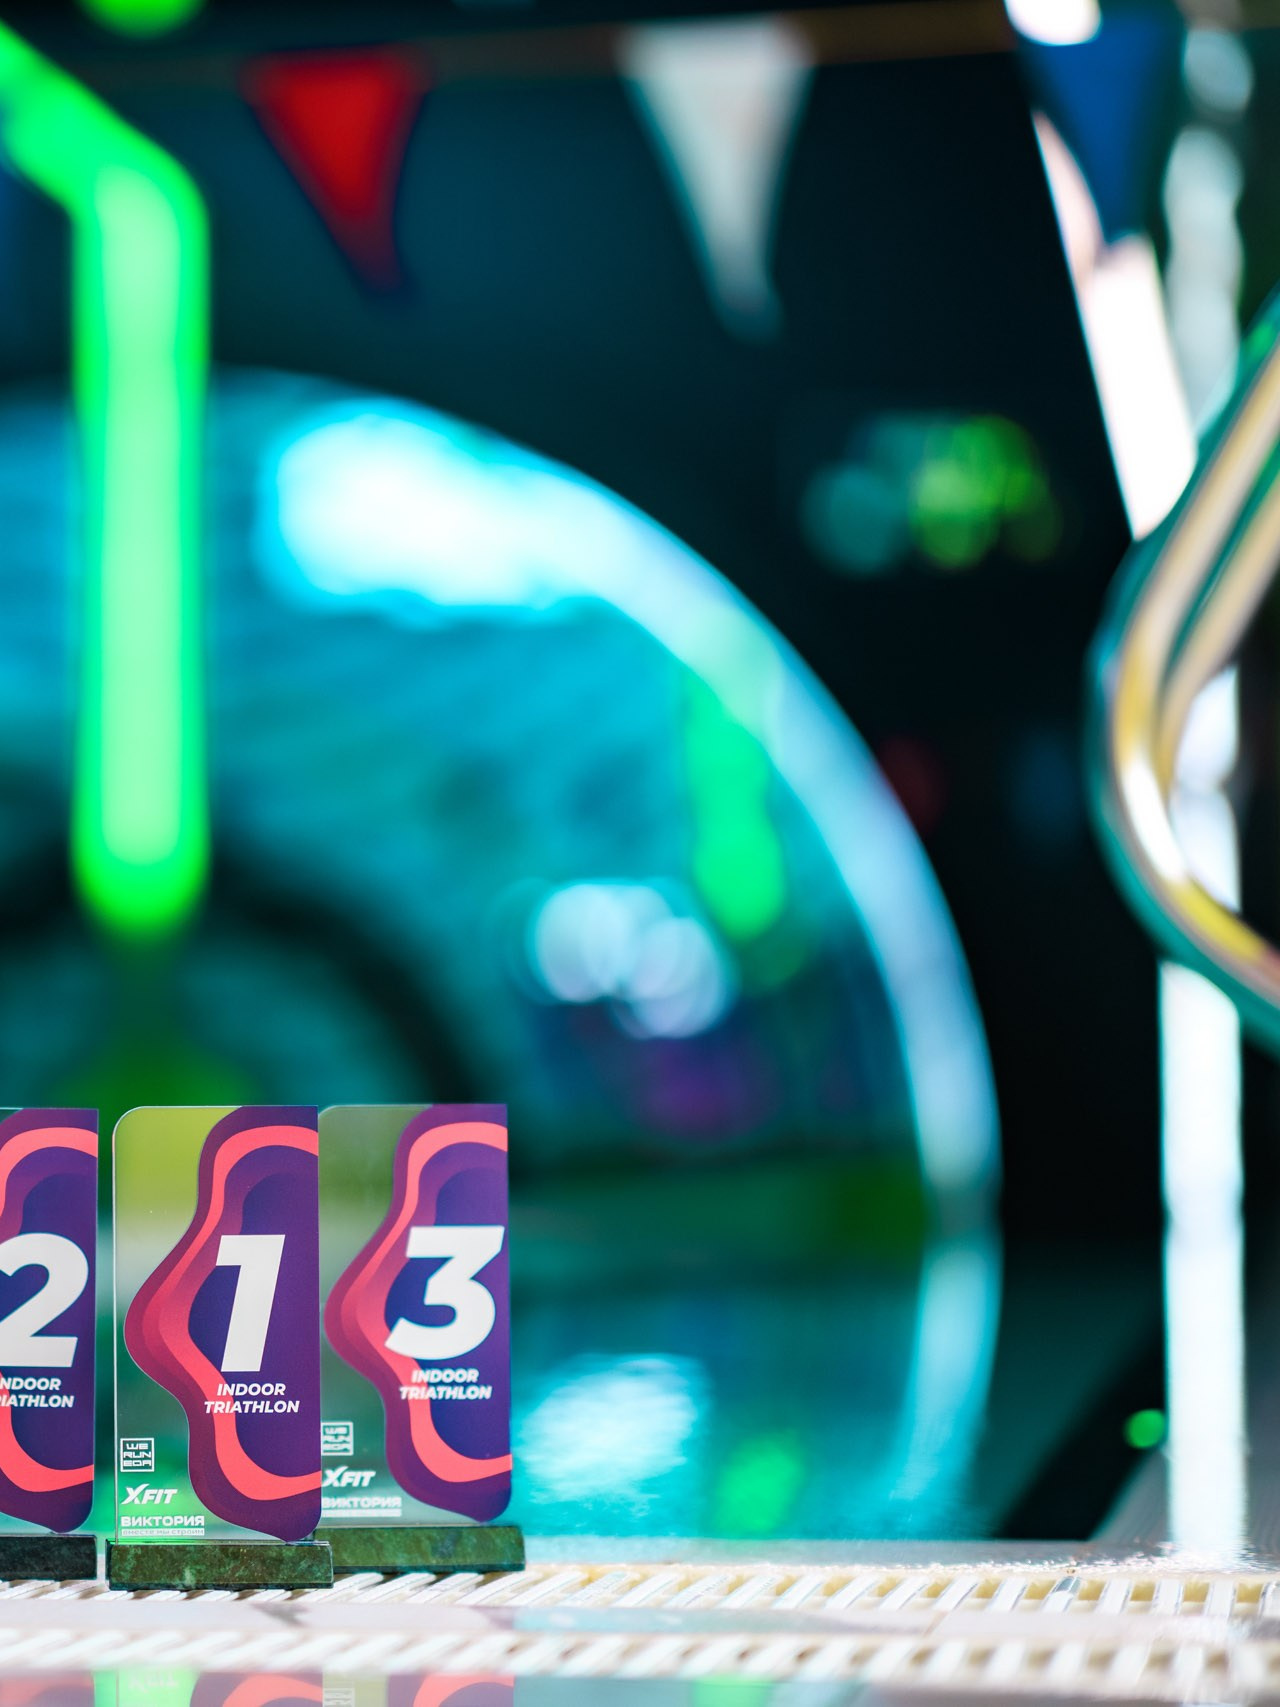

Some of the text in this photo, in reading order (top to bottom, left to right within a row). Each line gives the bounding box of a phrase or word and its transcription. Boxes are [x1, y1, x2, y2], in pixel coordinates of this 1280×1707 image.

[384, 1225, 505, 1361] 3
[216, 1234, 286, 1373] 1
[411, 1369, 480, 1384] INDOOR
[216, 1383, 286, 1397] INDOOR
[399, 1385, 493, 1401] TRIATHLON
[204, 1400, 301, 1415] TRIATHLON
[322, 1465, 376, 1487] XFIT
[121, 1483, 178, 1504] XFIT
[321, 1497, 402, 1508] ВИКТОРИЯ
[121, 1515, 205, 1527] ВИКТОРИЯ
